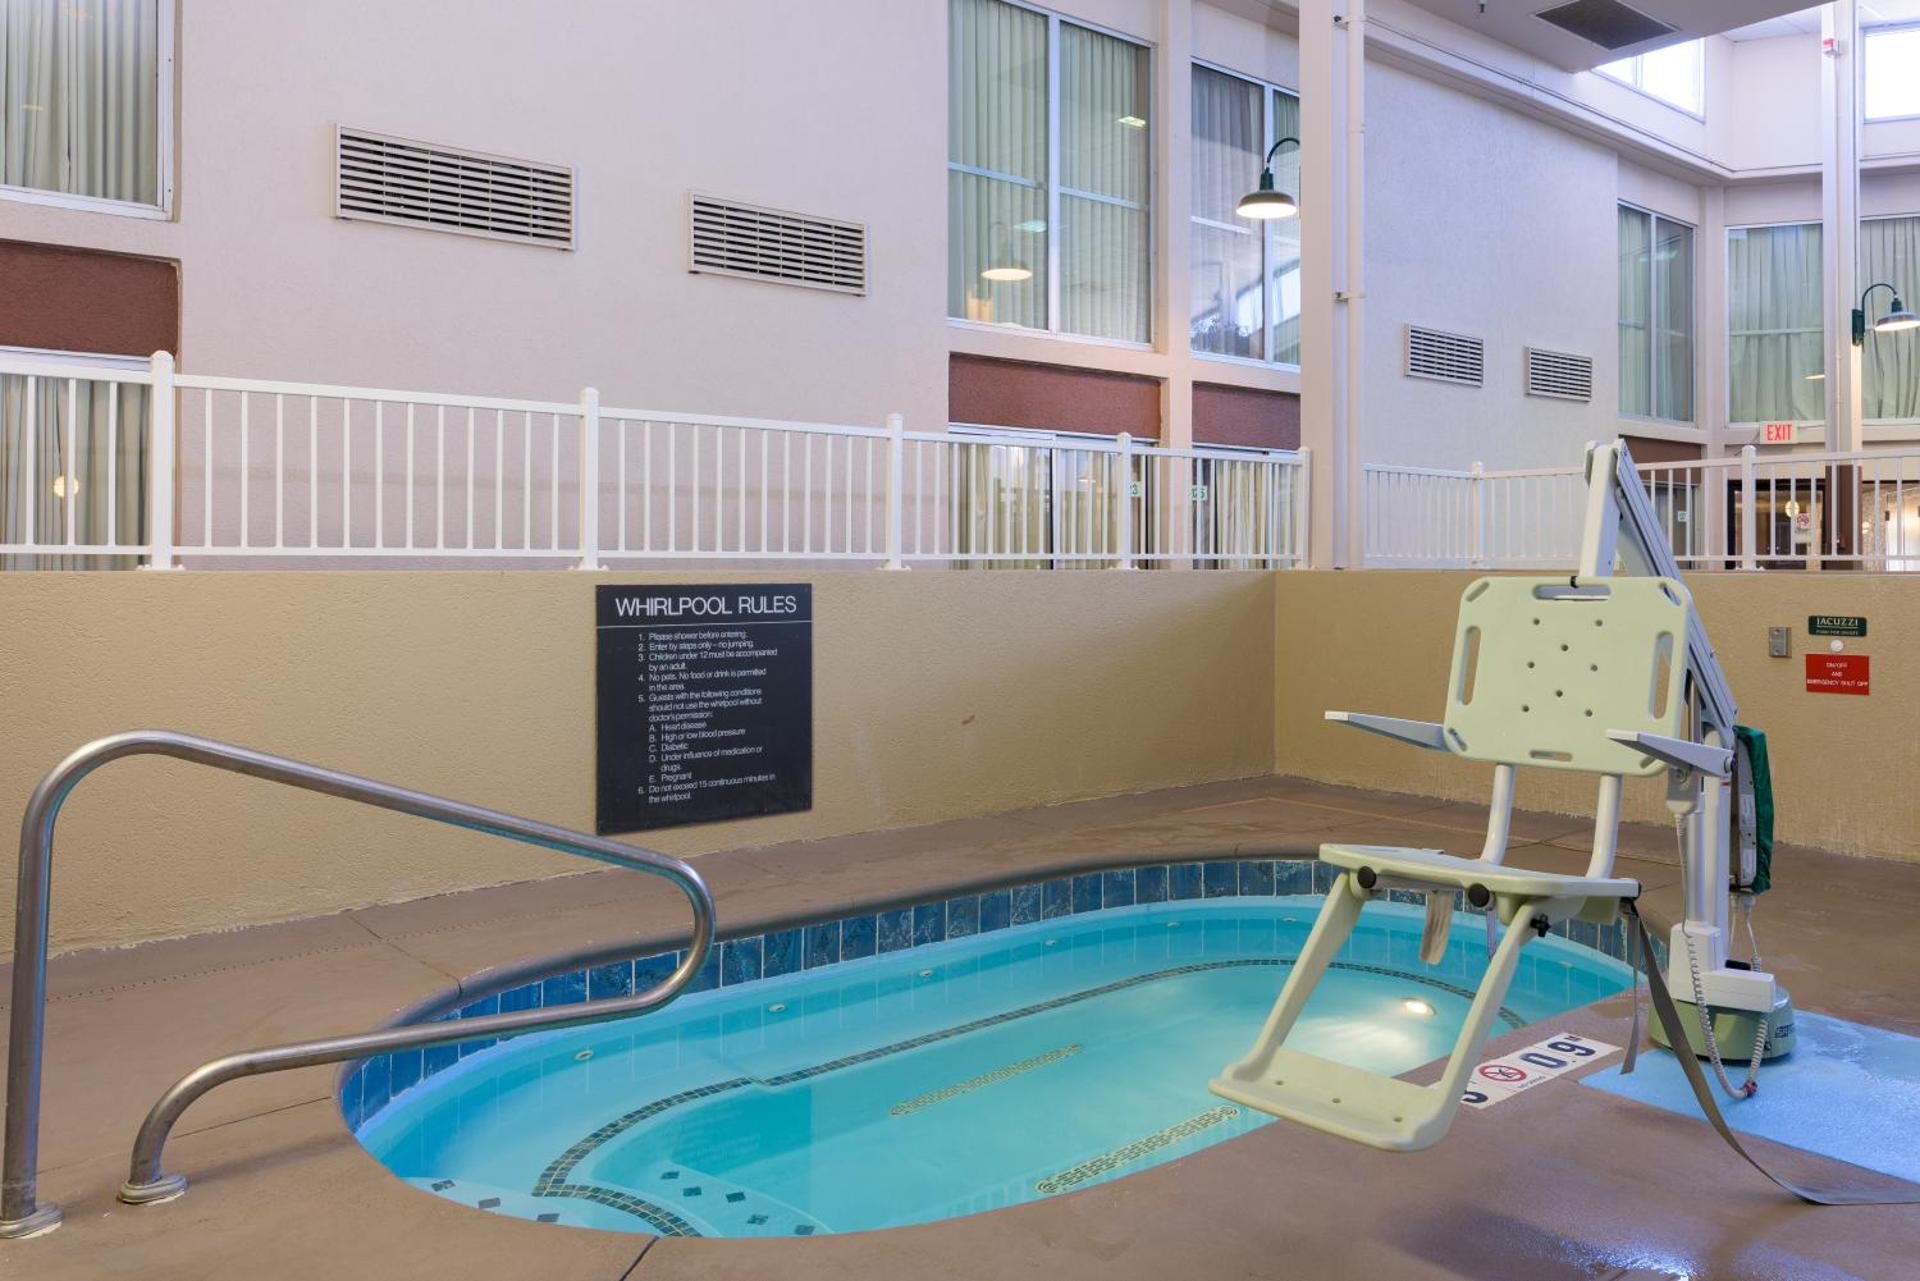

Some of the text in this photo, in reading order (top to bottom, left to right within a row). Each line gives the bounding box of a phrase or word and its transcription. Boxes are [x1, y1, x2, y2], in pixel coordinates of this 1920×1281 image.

[1766, 424, 1792, 441] EXIT
[615, 595, 797, 617] WHIRLPOOL RULES
[1816, 617, 1858, 626] JACUZZI
[649, 633, 673, 641] Please
[674, 632, 698, 640] shower
[699, 630, 720, 639] before
[649, 643, 668, 651] Enter
[669, 642, 677, 651] by
[698, 641, 712, 651] only
[649, 652, 678, 661] Children
[679, 651, 699, 660] under
[709, 650, 725, 658] must
[735, 648, 778, 658] accompanied
[649, 664, 659, 672] by
[649, 672, 660, 681] No
[679, 671, 689, 680] No
[690, 670, 705, 679] food
[714, 669, 730, 678] drink
[737, 667, 767, 678] permitted
[657, 683, 668, 691] the
[649, 693, 674, 702] Guests
[675, 691, 689, 700] with
[689, 691, 701, 699] the
[701, 689, 729, 699] following
[730, 687, 762, 697] conditions
[649, 697, 762, 712] should not use the whirlpool without
[661, 722, 681, 731] Heart
[661, 732, 678, 742] High
[686, 731, 698, 740] low
[698, 729, 717, 738] blood
[718, 728, 746, 737] pressure
[661, 742, 689, 752] Diabetic
[661, 752, 682, 762] Under
[683, 750, 712, 760] influence
[720, 746, 755, 756] medication
[661, 771, 692, 783] Pregnant
[649, 784, 660, 793] Do
[661, 784, 673, 792] not
[673, 781, 698, 790] exceed
[708, 777, 743, 787] continuous
[743, 774, 769, 783] minutes
[649, 795, 660, 804] the
